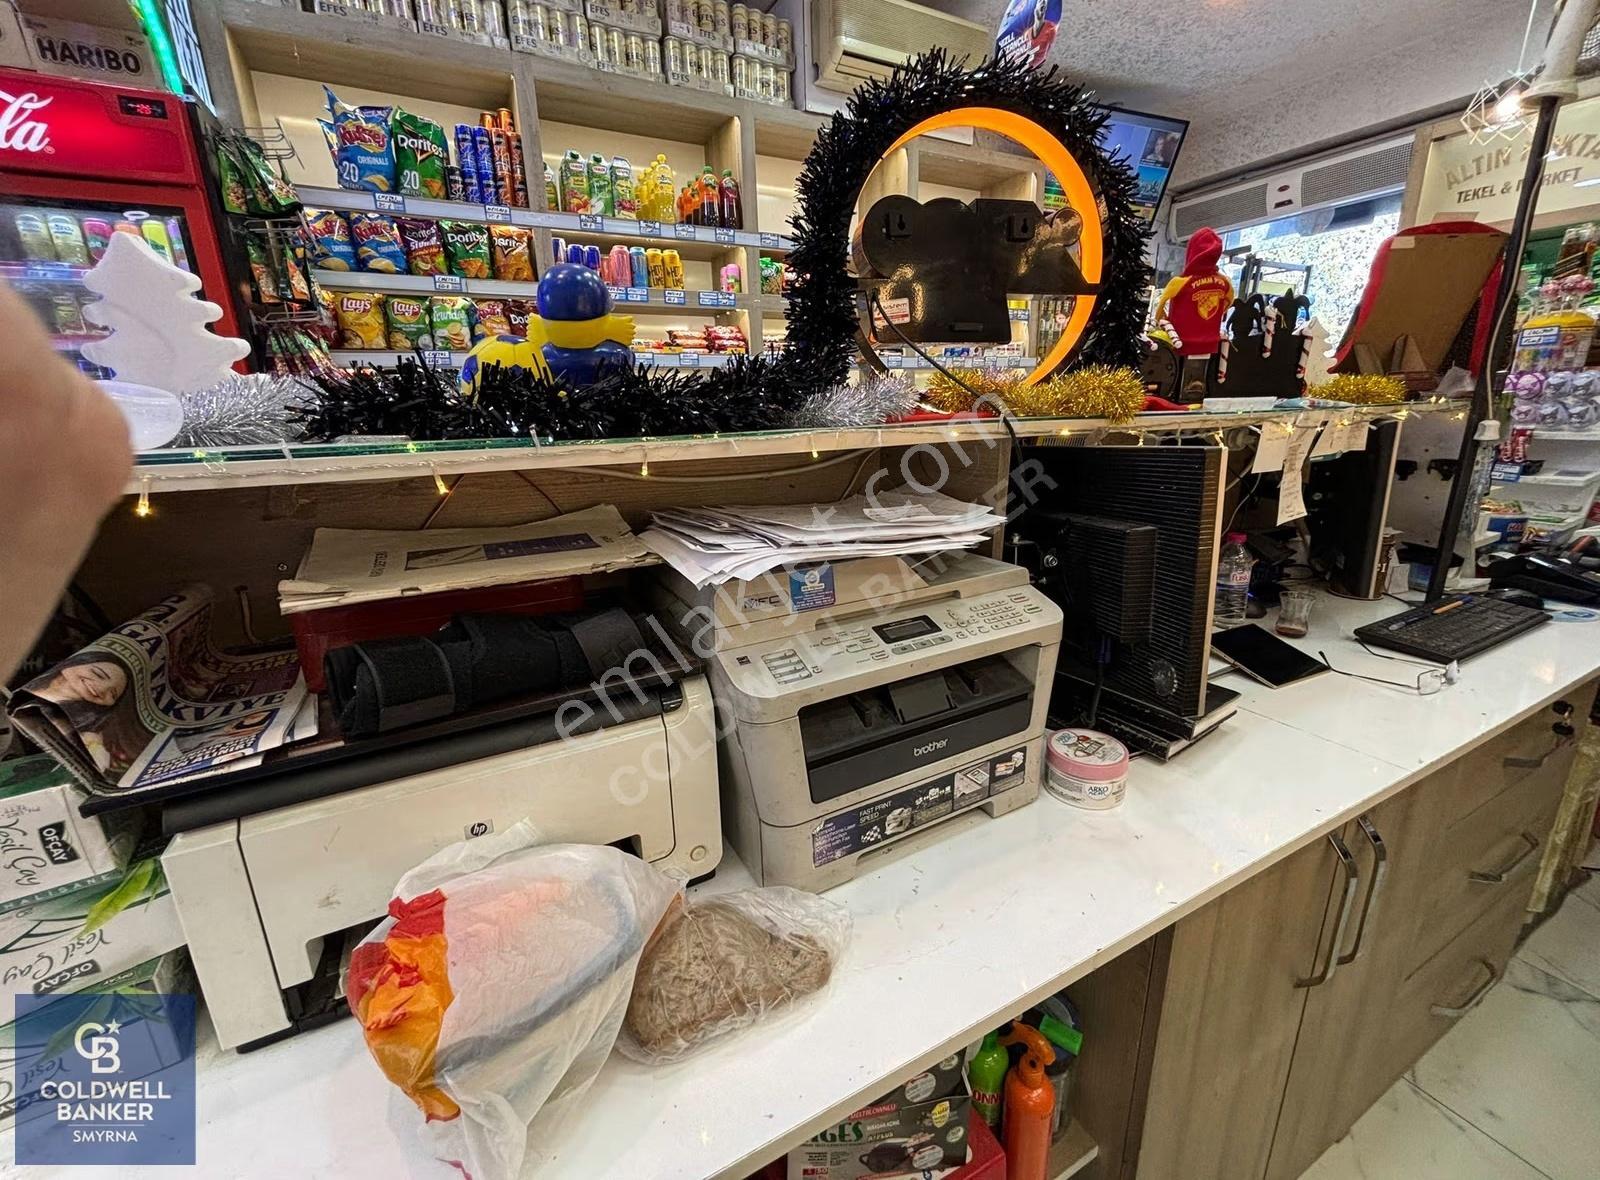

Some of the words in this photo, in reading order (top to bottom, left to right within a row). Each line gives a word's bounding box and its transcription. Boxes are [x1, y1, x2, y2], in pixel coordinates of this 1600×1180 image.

[320, 2, 348, 16] EFES
[424, 22, 448, 36] EFES
[36, 36, 141, 74] HARIBO
[397, 134, 443, 158] Doritos
[1456, 185, 1496, 204] TEKEL
[341, 297, 372, 314] Lay's
[393, 300, 421, 317] Lay's
[913, 738, 949, 757] brother
[1087, 785, 1110, 793] ARKO
[860, 804, 876, 817] FAST
[875, 800, 893, 813] PRINT
[860, 811, 880, 824] SPEED
[471, 821, 487, 837] hp
[42, 827, 68, 862] OFÇAY
[3, 856, 47, 886] Çay
[3, 952, 54, 985] Çay
[39, 961, 94, 993] OFÇAY
